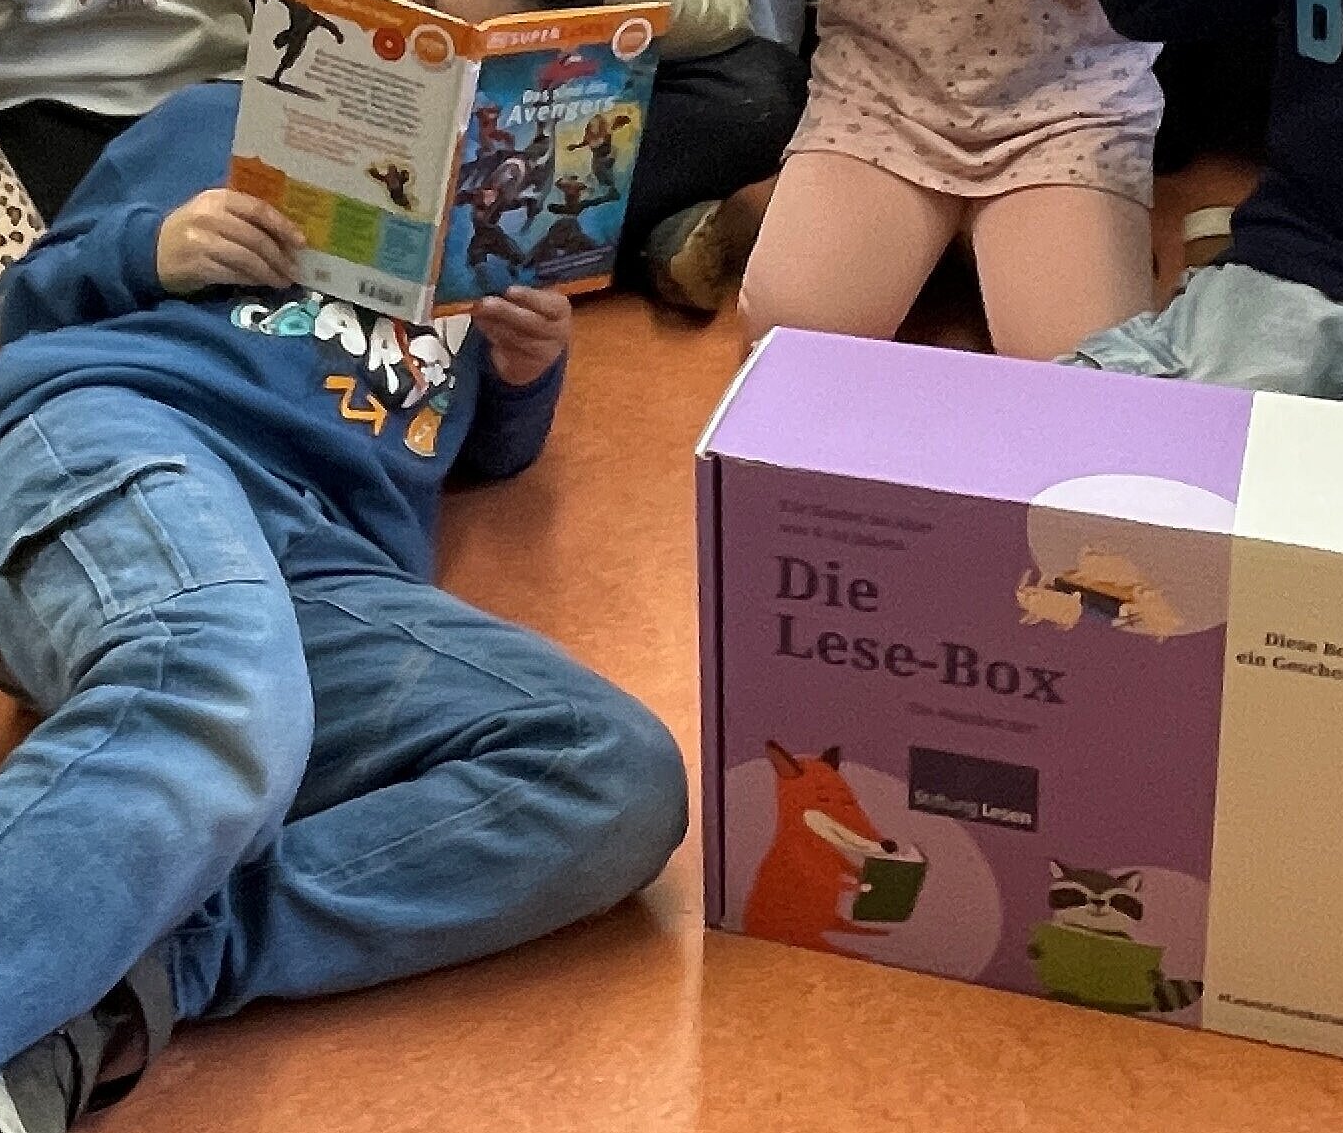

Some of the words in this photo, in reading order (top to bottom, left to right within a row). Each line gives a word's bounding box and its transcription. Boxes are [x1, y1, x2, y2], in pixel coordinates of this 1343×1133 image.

[774, 555, 879, 612] Die
[1265, 631, 1318, 652] Diese
[774, 613, 1066, 704] Lese-Box
[1236, 651, 1266, 667] ein
[982, 803, 1033, 825] Lesen
